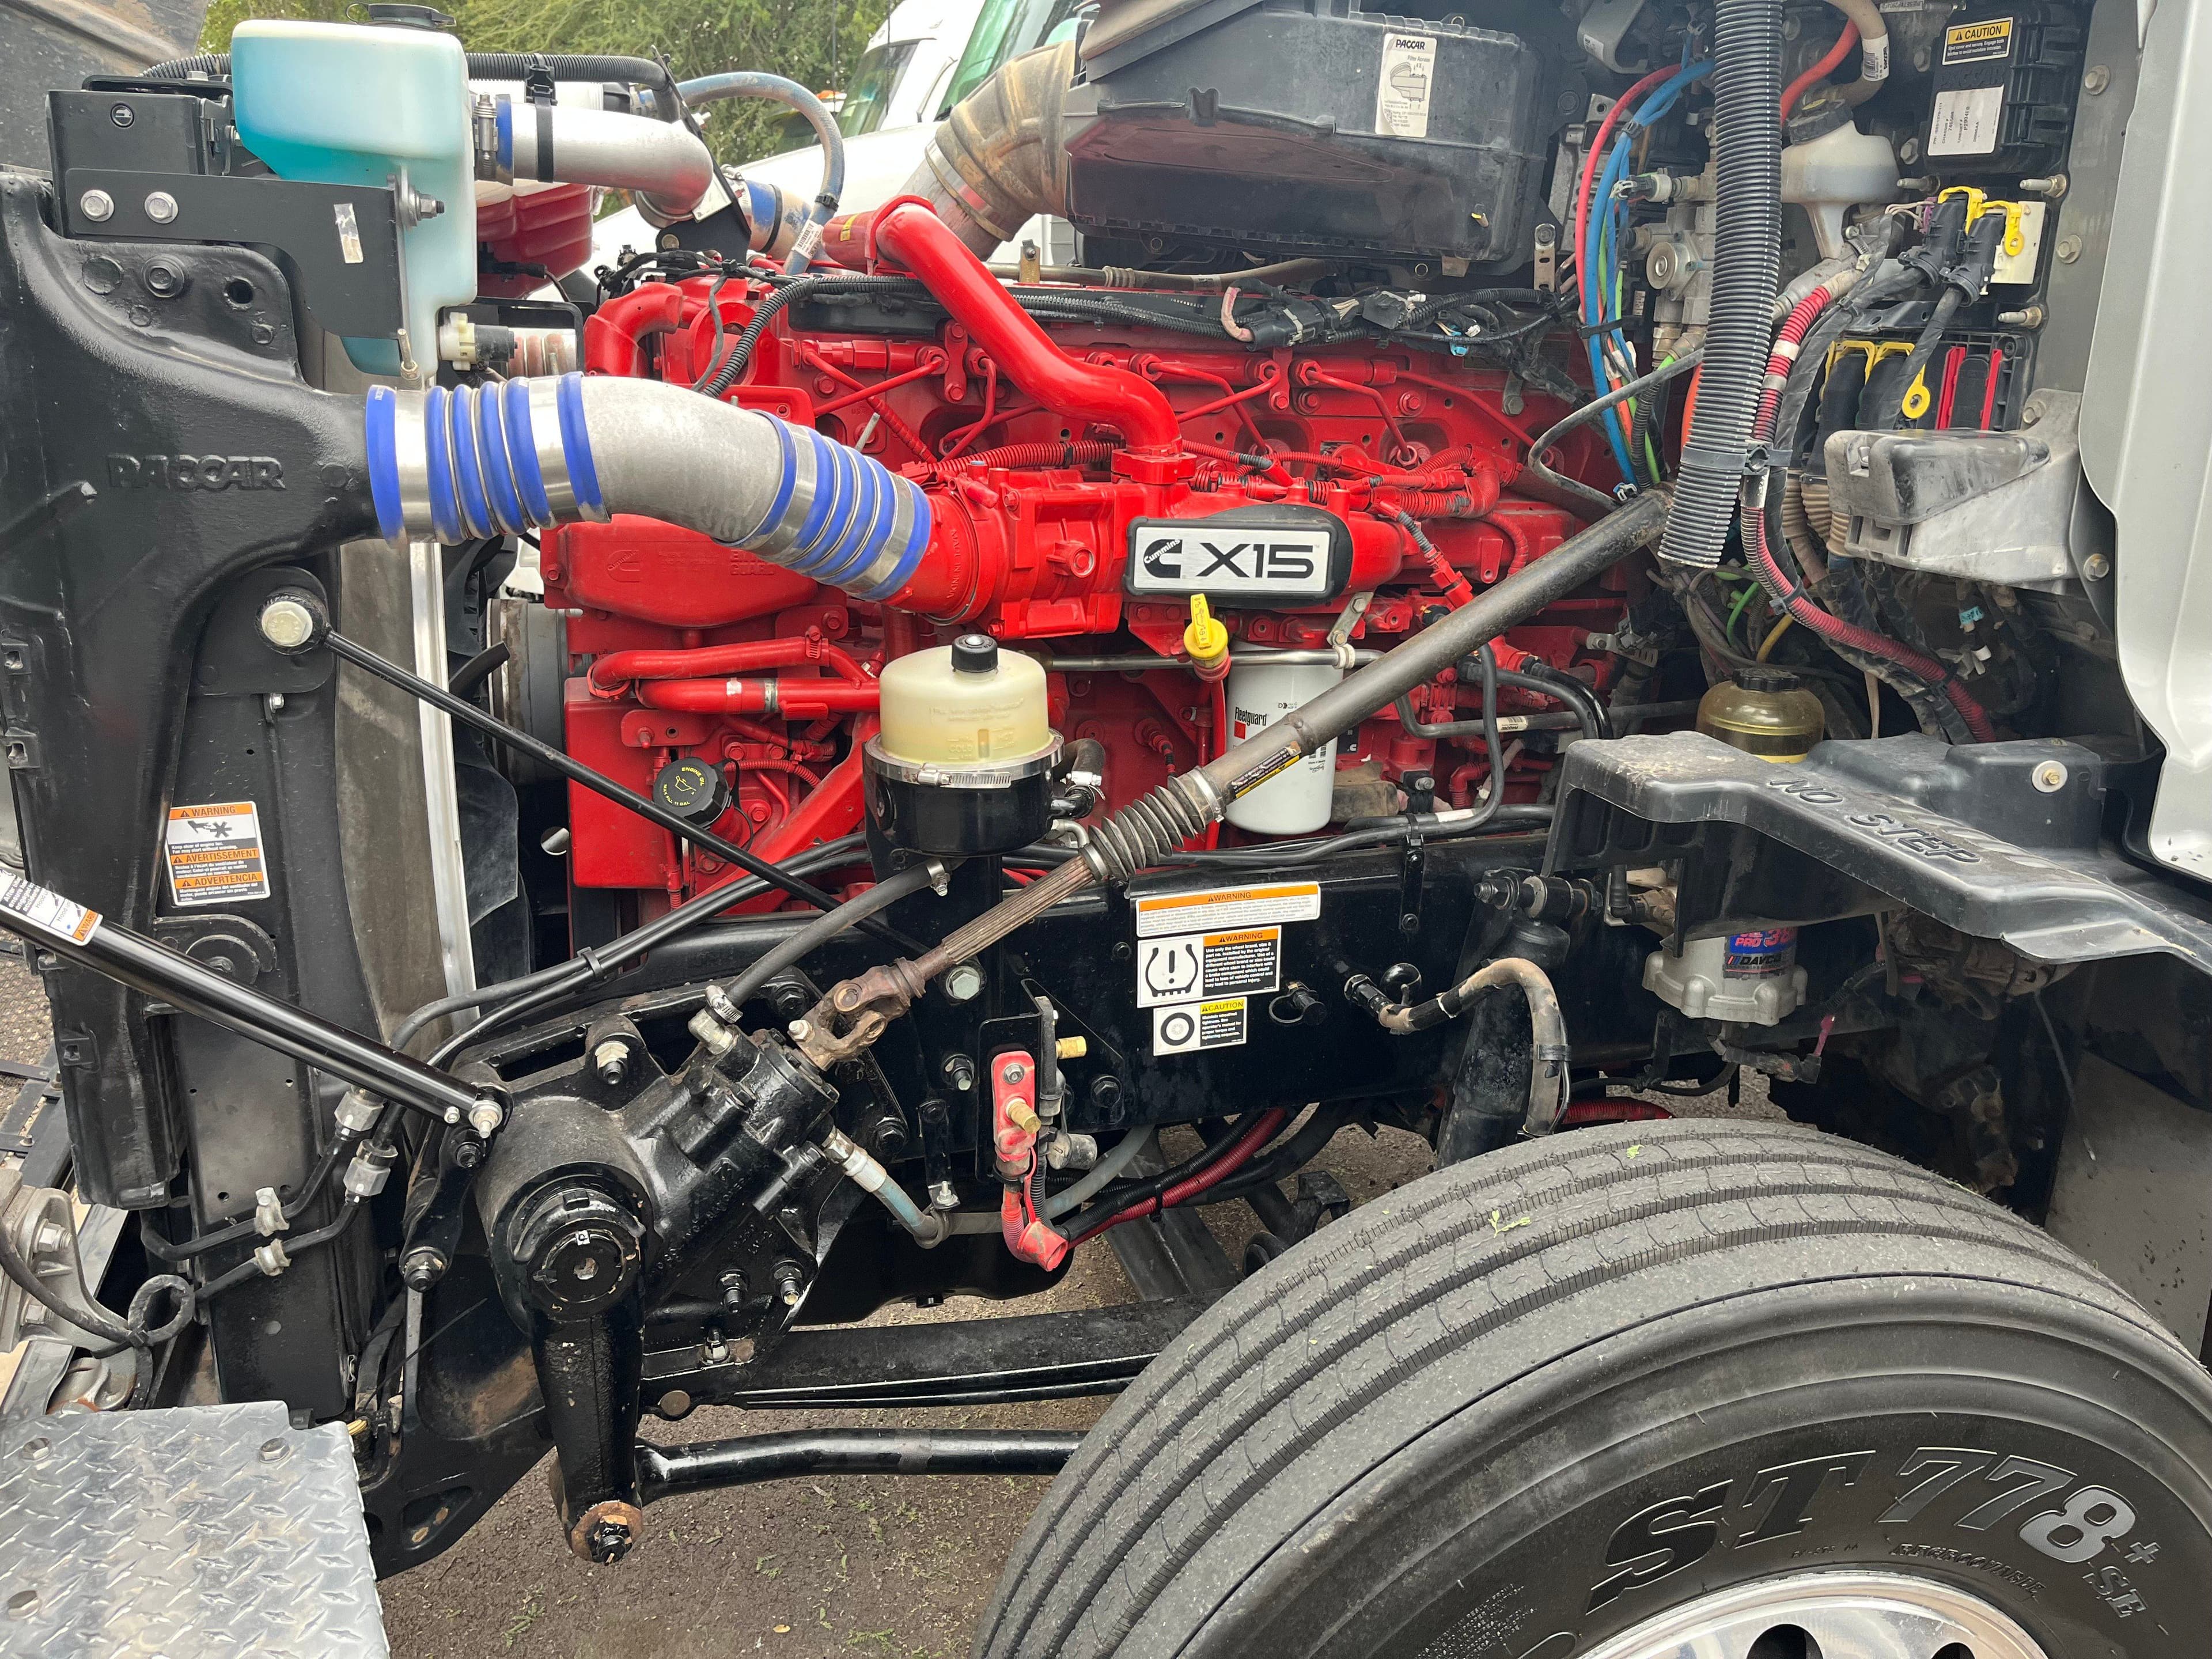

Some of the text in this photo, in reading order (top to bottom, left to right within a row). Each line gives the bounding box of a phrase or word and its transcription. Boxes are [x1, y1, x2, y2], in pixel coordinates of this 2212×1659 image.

[1965, 25, 2002, 39] CAUTION
[1396, 39, 1425, 50] PACCAR
[107, 454, 287, 490] PACCAR
[1143, 539, 1314, 579] Cummins X15
[1234, 706, 1267, 726] Fleetguard
[682, 767, 702, 778] ENGINE
[192, 806, 236, 817] WARNING
[1770, 778, 1981, 863] NO STEP
[187, 849, 257, 862] AVERTISSEMENT
[195, 873, 257, 886] ADVERTENCIA
[3, 887, 16, 903] After
[9, 888, 24, 908] ensure
[1214, 892, 1251, 902] WARNING
[1226, 933, 1263, 942] WARNING
[1735, 937, 1762, 948] PRO
[1209, 1001, 1243, 1011] CAUTION
[1586, 1450, 1876, 1615] ST
[1889, 1543, 2046, 1598] REGROOVABLE
